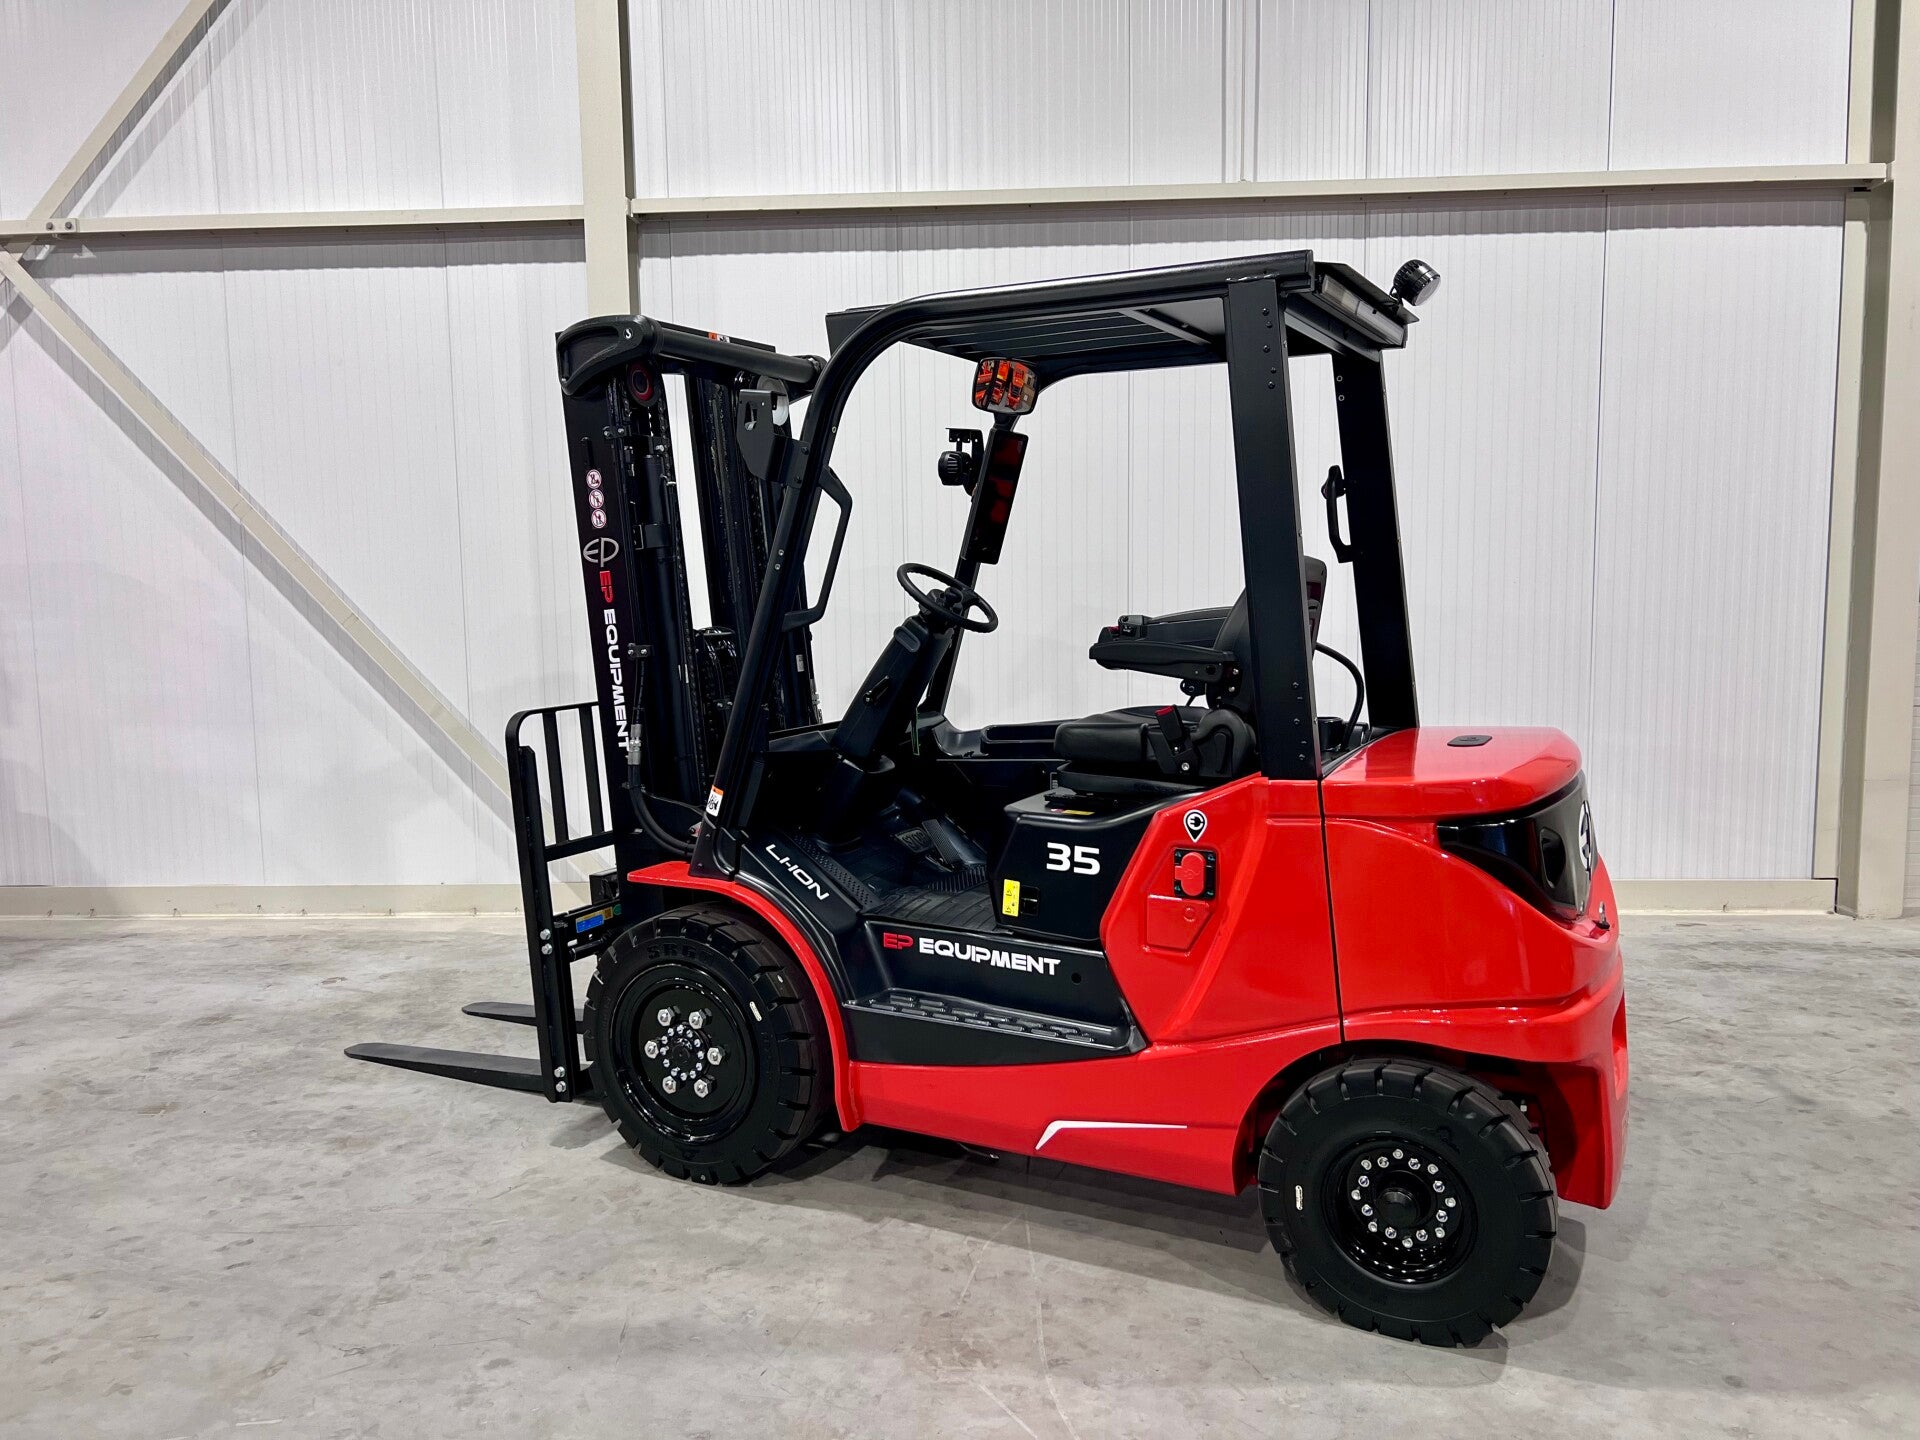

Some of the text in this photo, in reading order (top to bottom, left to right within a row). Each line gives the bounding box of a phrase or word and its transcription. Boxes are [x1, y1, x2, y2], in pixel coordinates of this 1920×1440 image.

[599, 570, 630, 752] EP EQUIPMENT
[1046, 842, 1100, 875] 35
[883, 932, 1061, 975] EP EQUIPMENT
